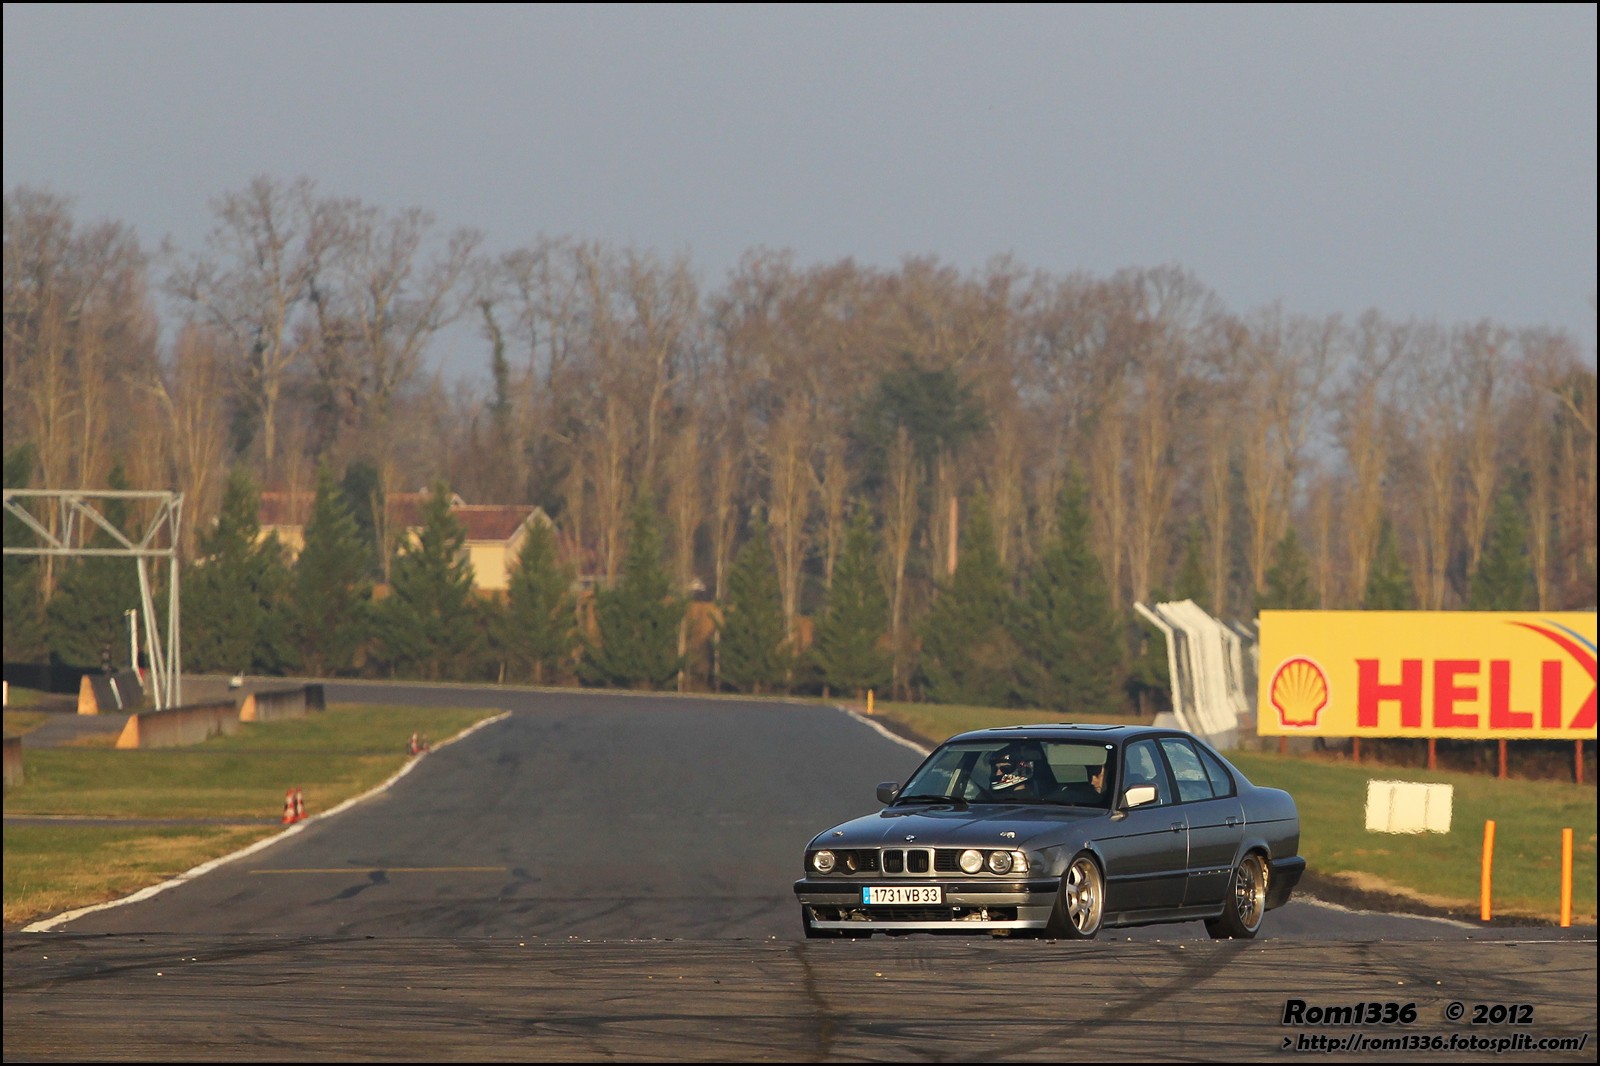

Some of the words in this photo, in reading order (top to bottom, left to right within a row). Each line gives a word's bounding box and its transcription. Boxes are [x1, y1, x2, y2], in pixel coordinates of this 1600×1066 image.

[874, 889, 901, 902] 1731
[904, 889, 920, 902] VB
[922, 889, 938, 902] 33
